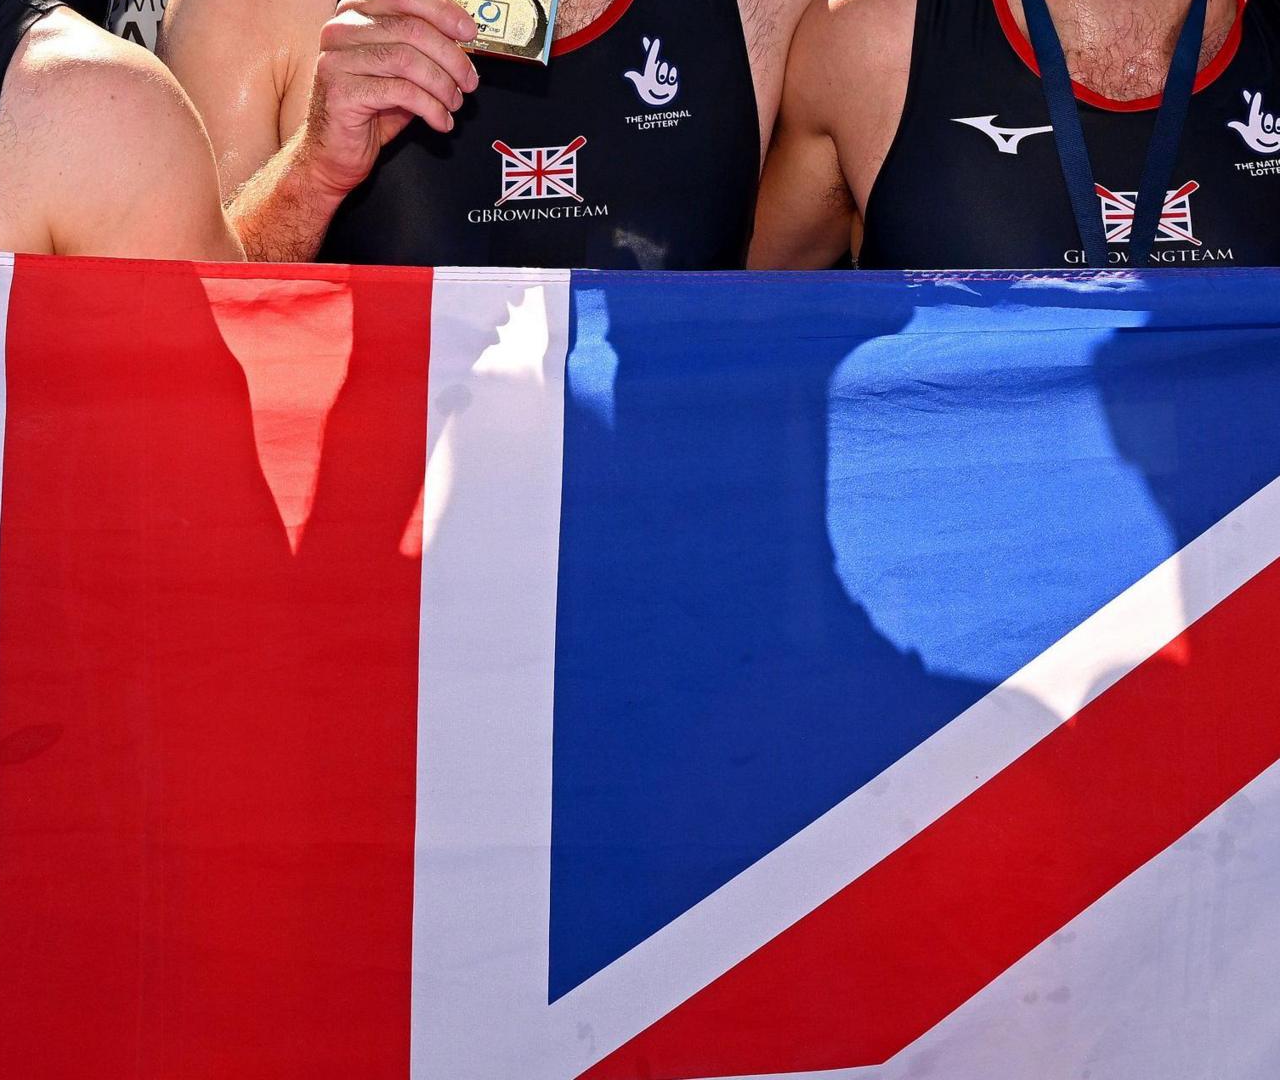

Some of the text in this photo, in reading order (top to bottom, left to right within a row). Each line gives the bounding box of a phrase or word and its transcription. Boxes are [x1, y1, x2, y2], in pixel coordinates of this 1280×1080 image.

[625, 110, 692, 124] THE NATIONAL
[638, 119, 679, 130] LOTTERY
[1234, 162, 1255, 171] THE
